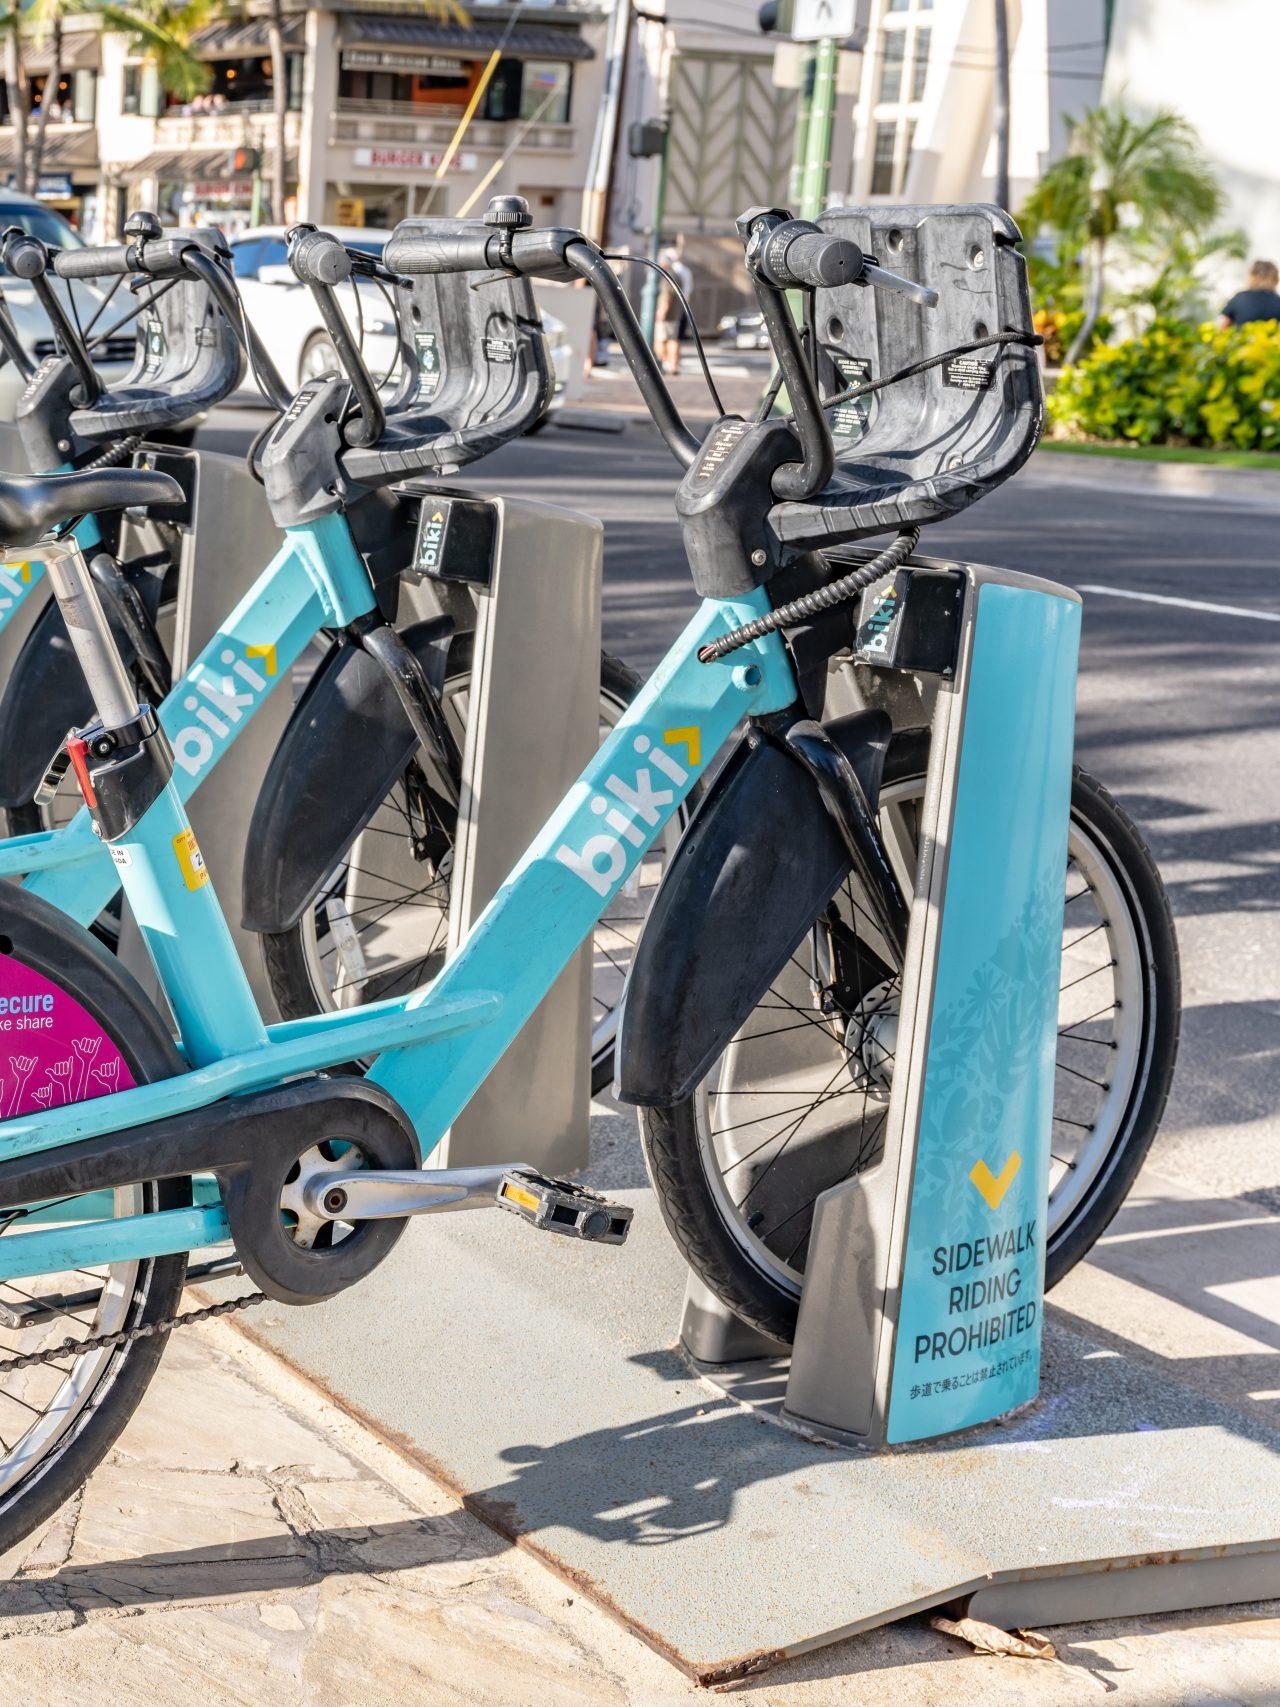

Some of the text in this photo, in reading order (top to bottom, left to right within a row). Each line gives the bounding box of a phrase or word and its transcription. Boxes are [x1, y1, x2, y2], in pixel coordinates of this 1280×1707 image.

[420, 521, 442, 565] biki
[863, 598, 895, 652] biki
[172, 649, 267, 777] biki
[555, 735, 689, 897] biki
[16, 1015, 54, 1031] share
[932, 1220, 1036, 1276] SIDEWALK
[949, 1268, 1022, 1315] RIDING
[914, 1301, 1036, 1364] PROHIBITED
